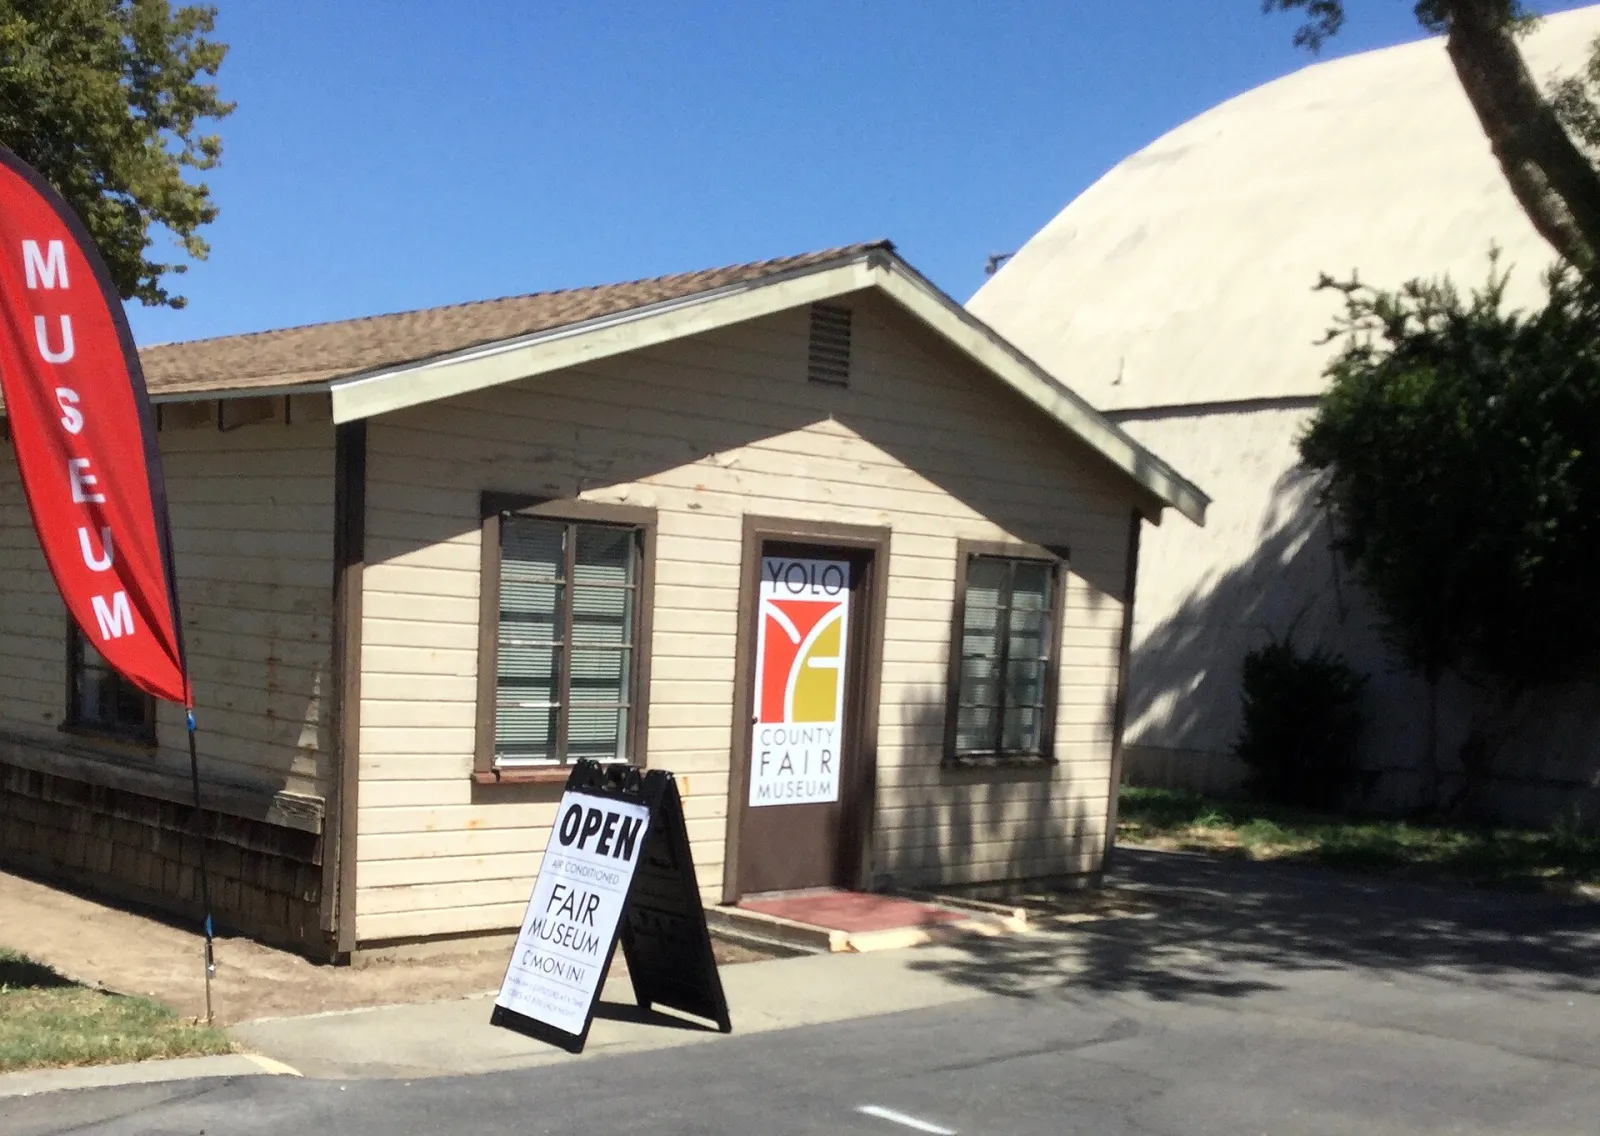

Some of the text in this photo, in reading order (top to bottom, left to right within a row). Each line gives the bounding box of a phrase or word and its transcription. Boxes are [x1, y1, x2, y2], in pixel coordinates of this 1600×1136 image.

[22, 239, 135, 640] MUSEUM
[767, 560, 844, 596] YOLO
[760, 727, 834, 746] COUNTY
[759, 749, 832, 777] FAIR
[756, 780, 832, 800] MUSEUM
[559, 803, 643, 861] OPEN
[564, 861, 619, 885] CONDITIONED
[546, 883, 601, 927] FAIR
[528, 917, 599, 956] MUSEUM
[565, 960, 585, 985] IN!
